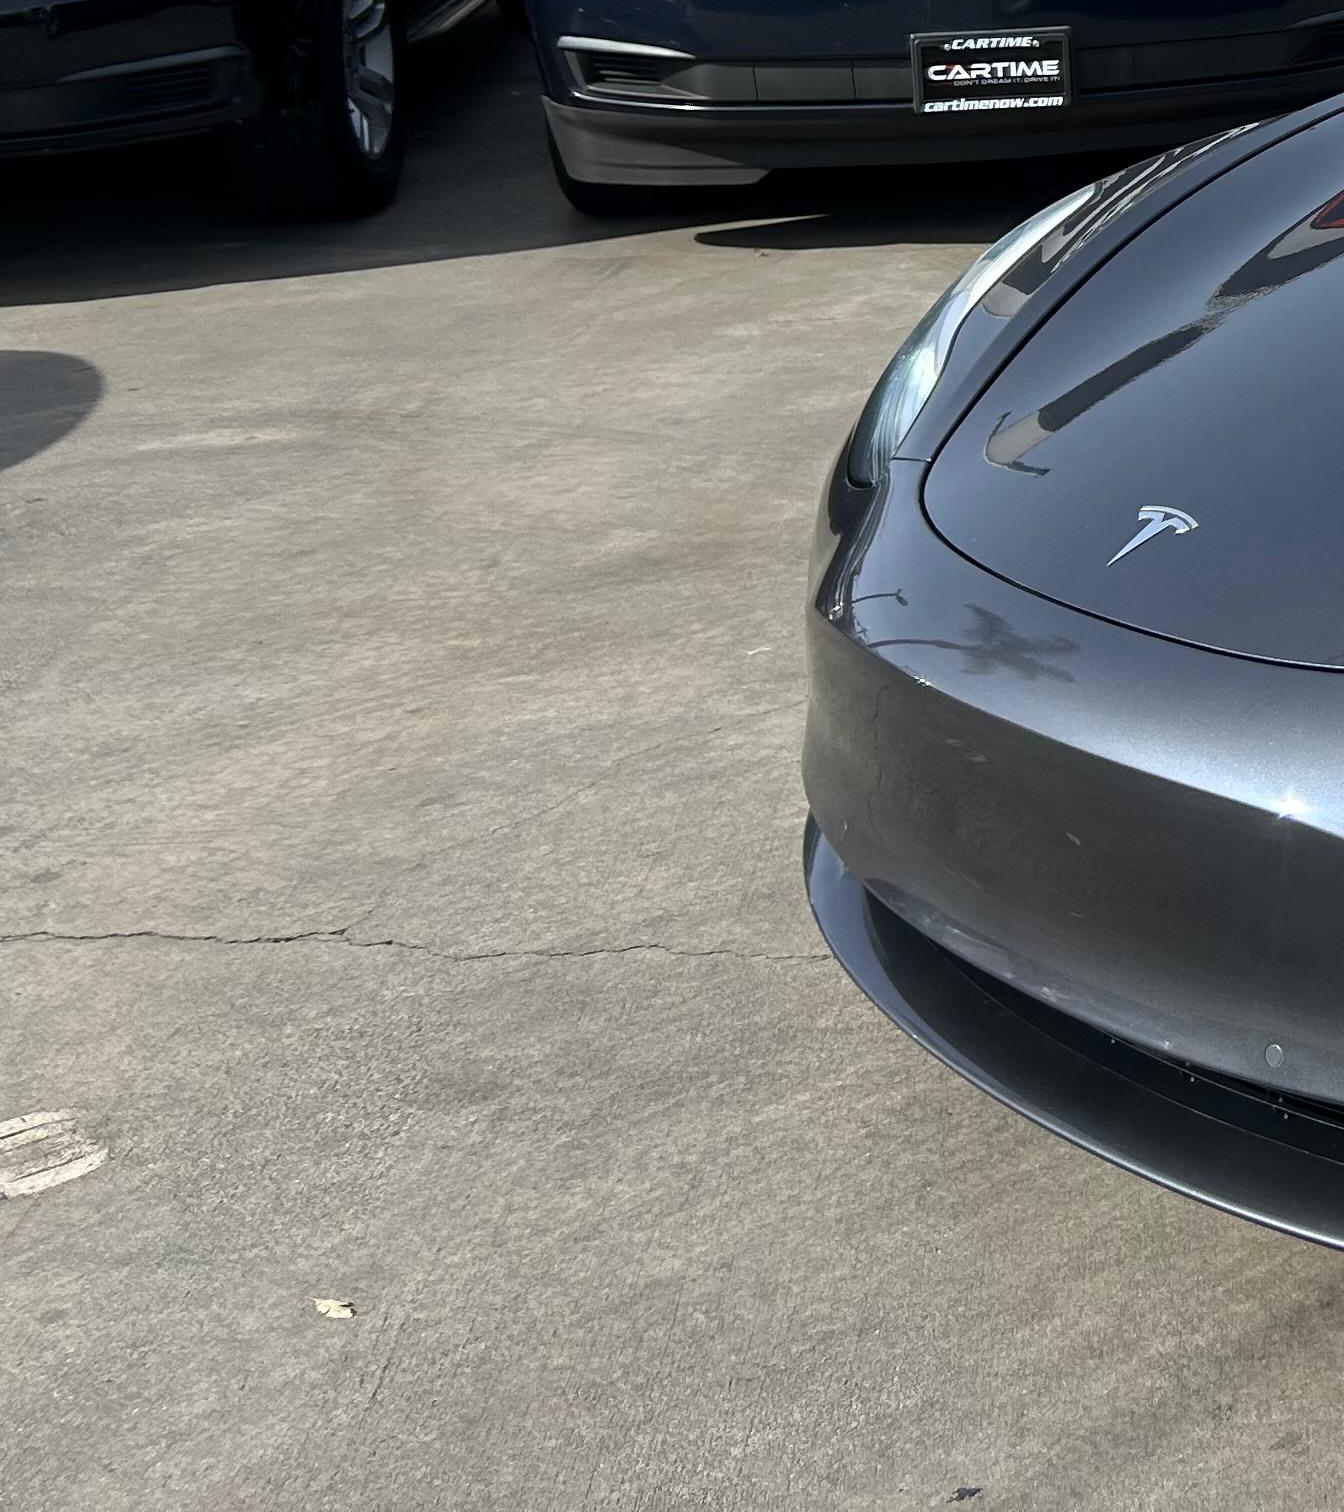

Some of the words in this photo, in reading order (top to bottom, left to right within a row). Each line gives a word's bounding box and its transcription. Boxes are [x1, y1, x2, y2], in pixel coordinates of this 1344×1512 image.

[952, 36, 1034, 50] CARTIME
[927, 59, 1060, 81] CARTIME
[924, 96, 1063, 113] cartimenow.com
